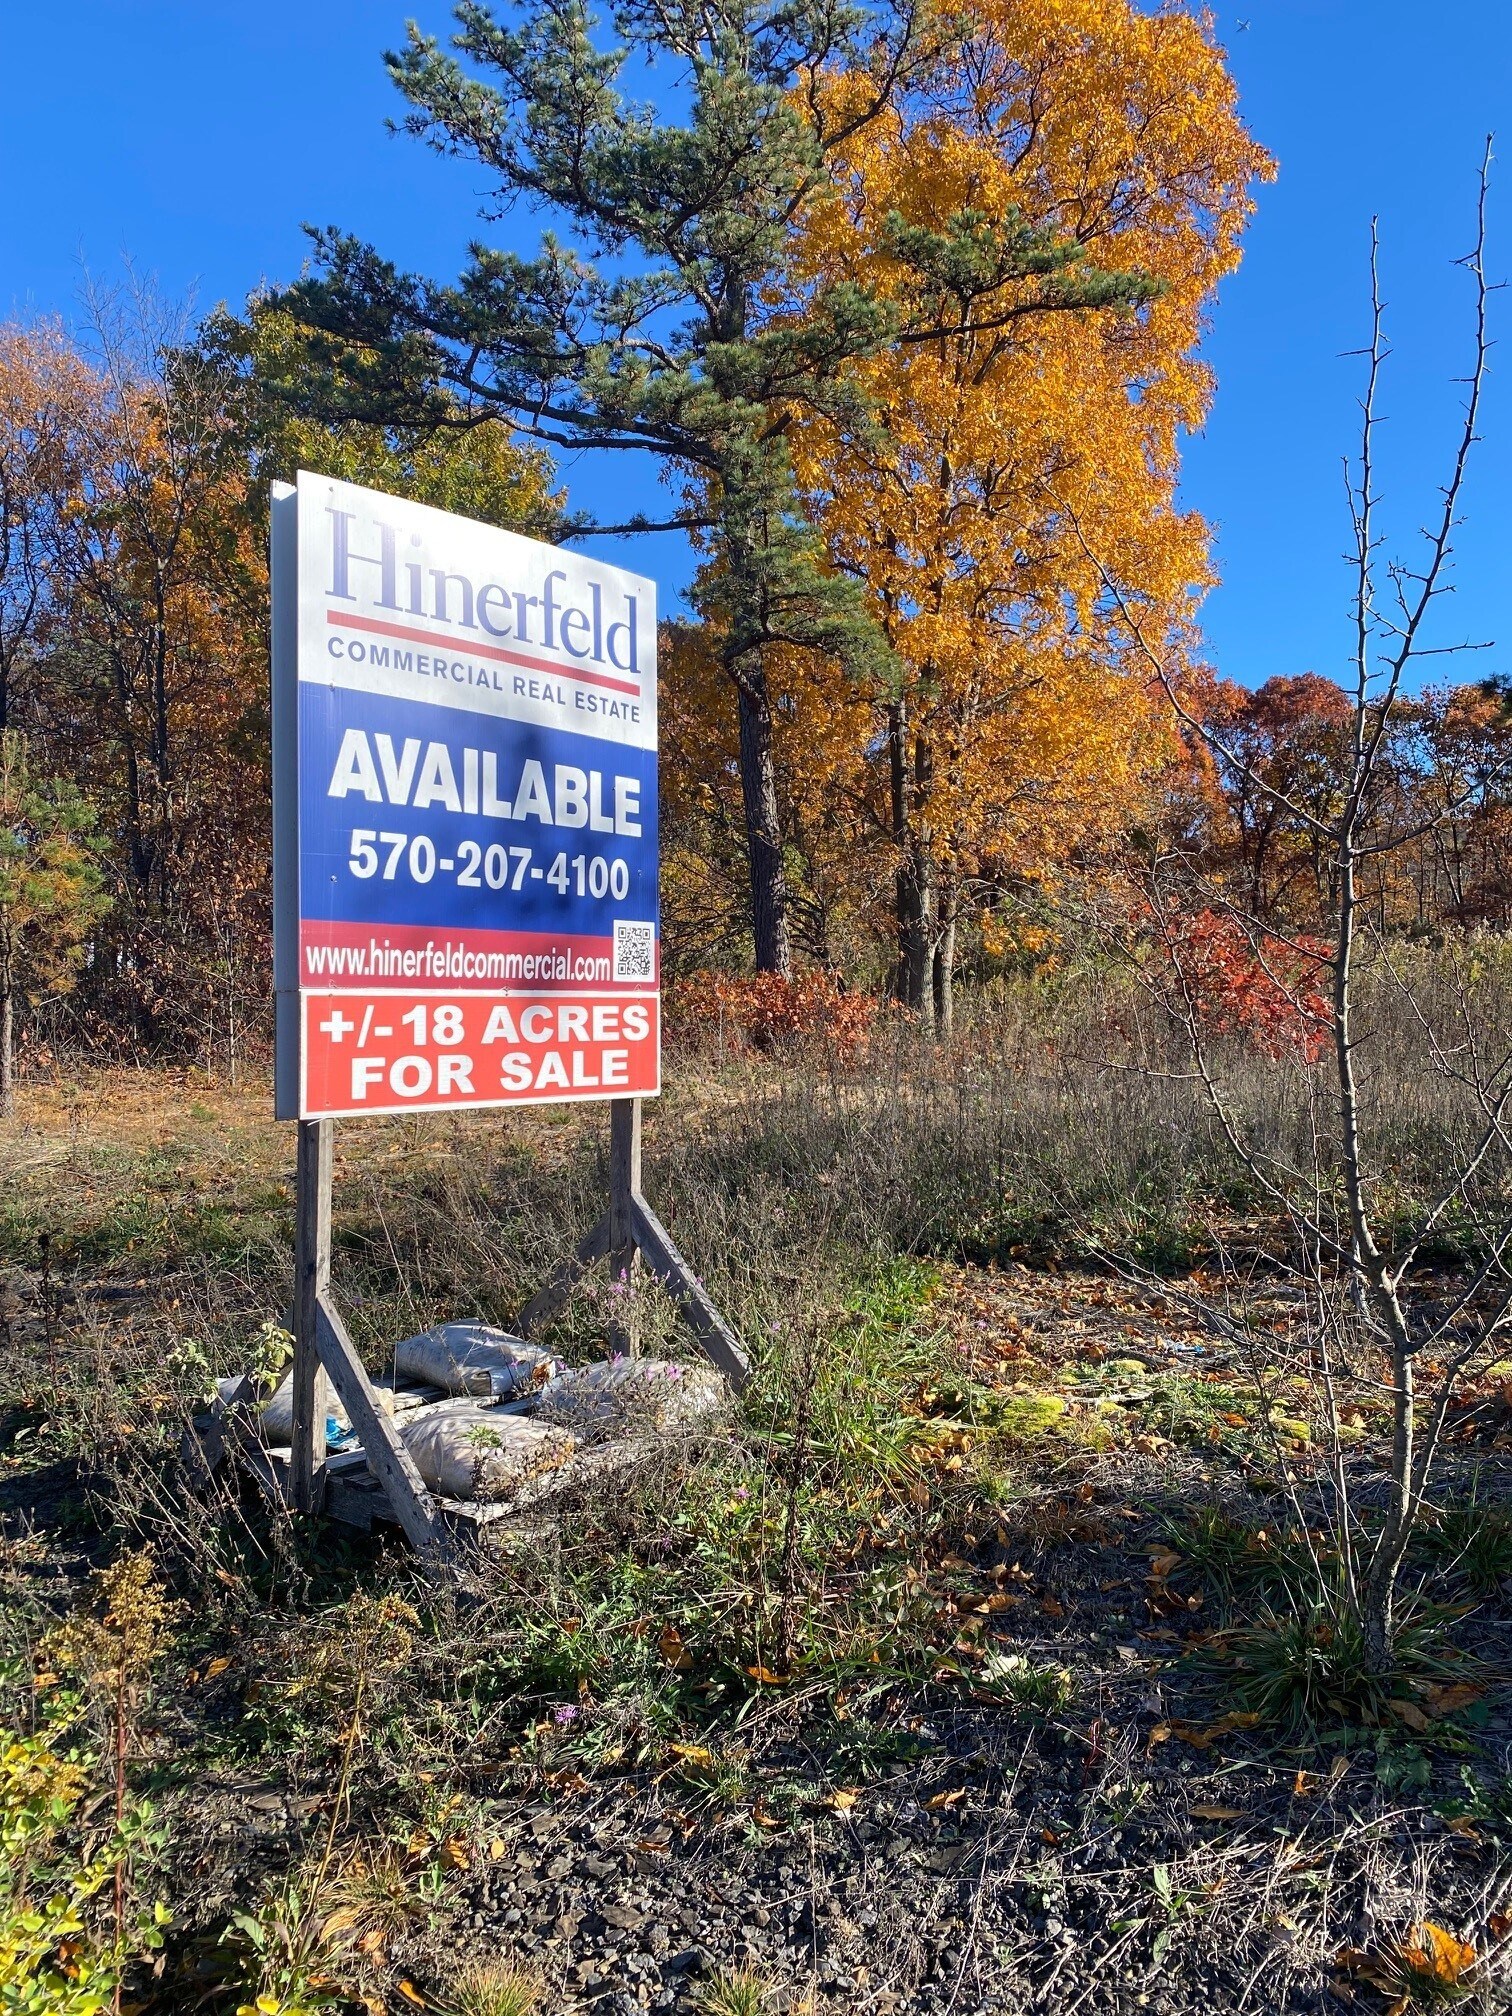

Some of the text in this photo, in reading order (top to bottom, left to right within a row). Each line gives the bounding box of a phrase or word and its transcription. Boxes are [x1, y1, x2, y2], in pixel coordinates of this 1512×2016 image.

[325, 507, 641, 674] Hinerfeld
[327, 636, 641, 724] COMMERCIAL REAL ESTATE
[327, 728, 642, 838] AVAILABLE
[349, 828, 630, 901] 570-207-4100
[306, 938, 611, 983] www.hinerfeldcommercial.com
[480, 1004, 650, 1044] ACRES
[350, 1049, 630, 1100] FOR SALE
